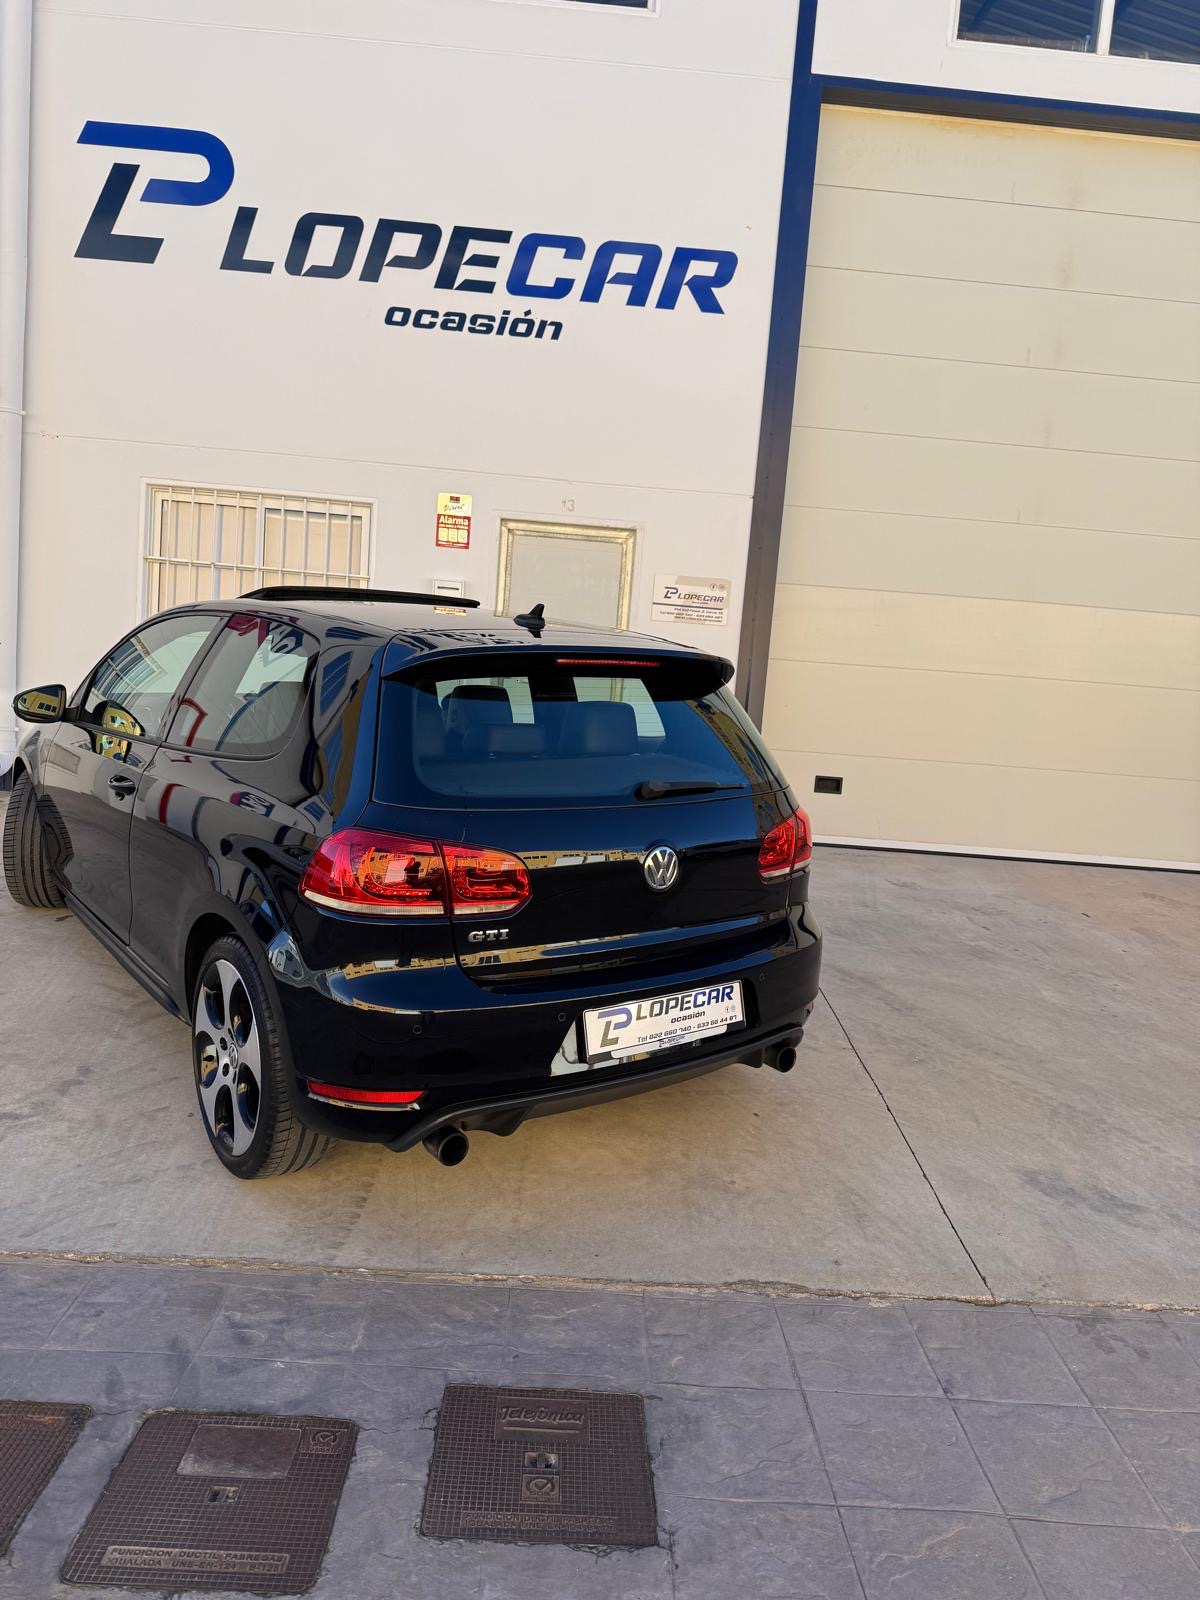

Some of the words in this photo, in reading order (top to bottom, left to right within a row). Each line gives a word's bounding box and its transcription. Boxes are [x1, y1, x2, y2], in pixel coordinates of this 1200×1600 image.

[220, 206, 739, 315] LOPECAR
[384, 305, 564, 341] ocasión
[561, 499, 575, 512] 13
[678, 593, 724, 602] LOPECAR
[468, 928, 509, 943] GTI
[635, 985, 734, 1020] LOPECAR
[671, 1010, 706, 1024] ocasión
[637, 1035, 648, 1043] Tel
[110, 1548, 173, 1558] FUNDICION
[178, 1551, 218, 1560] DUCTIL
